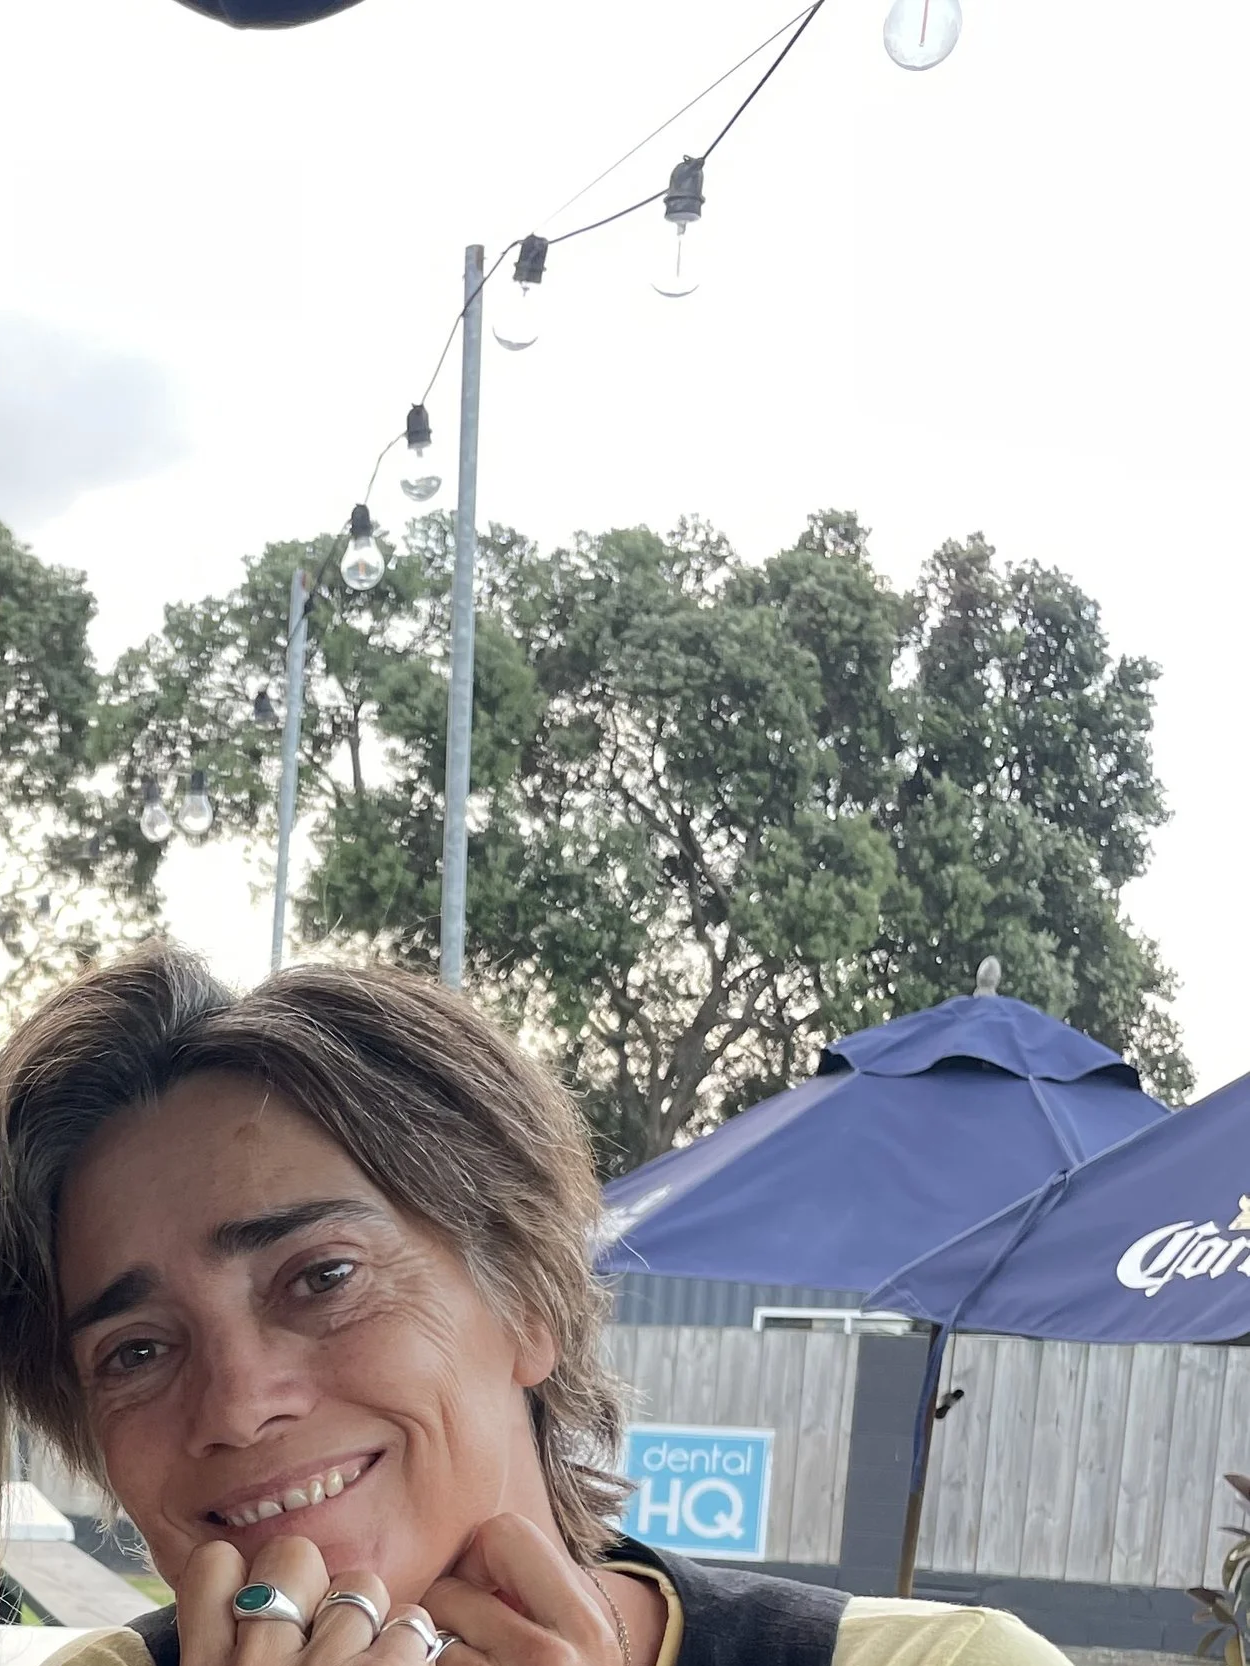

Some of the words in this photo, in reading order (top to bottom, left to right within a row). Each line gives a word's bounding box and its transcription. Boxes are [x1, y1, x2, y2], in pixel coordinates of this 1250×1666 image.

[1116, 1221, 1250, 1298] Cor
[642, 1441, 753, 1476] dental
[637, 1476, 745, 1540] HQ
